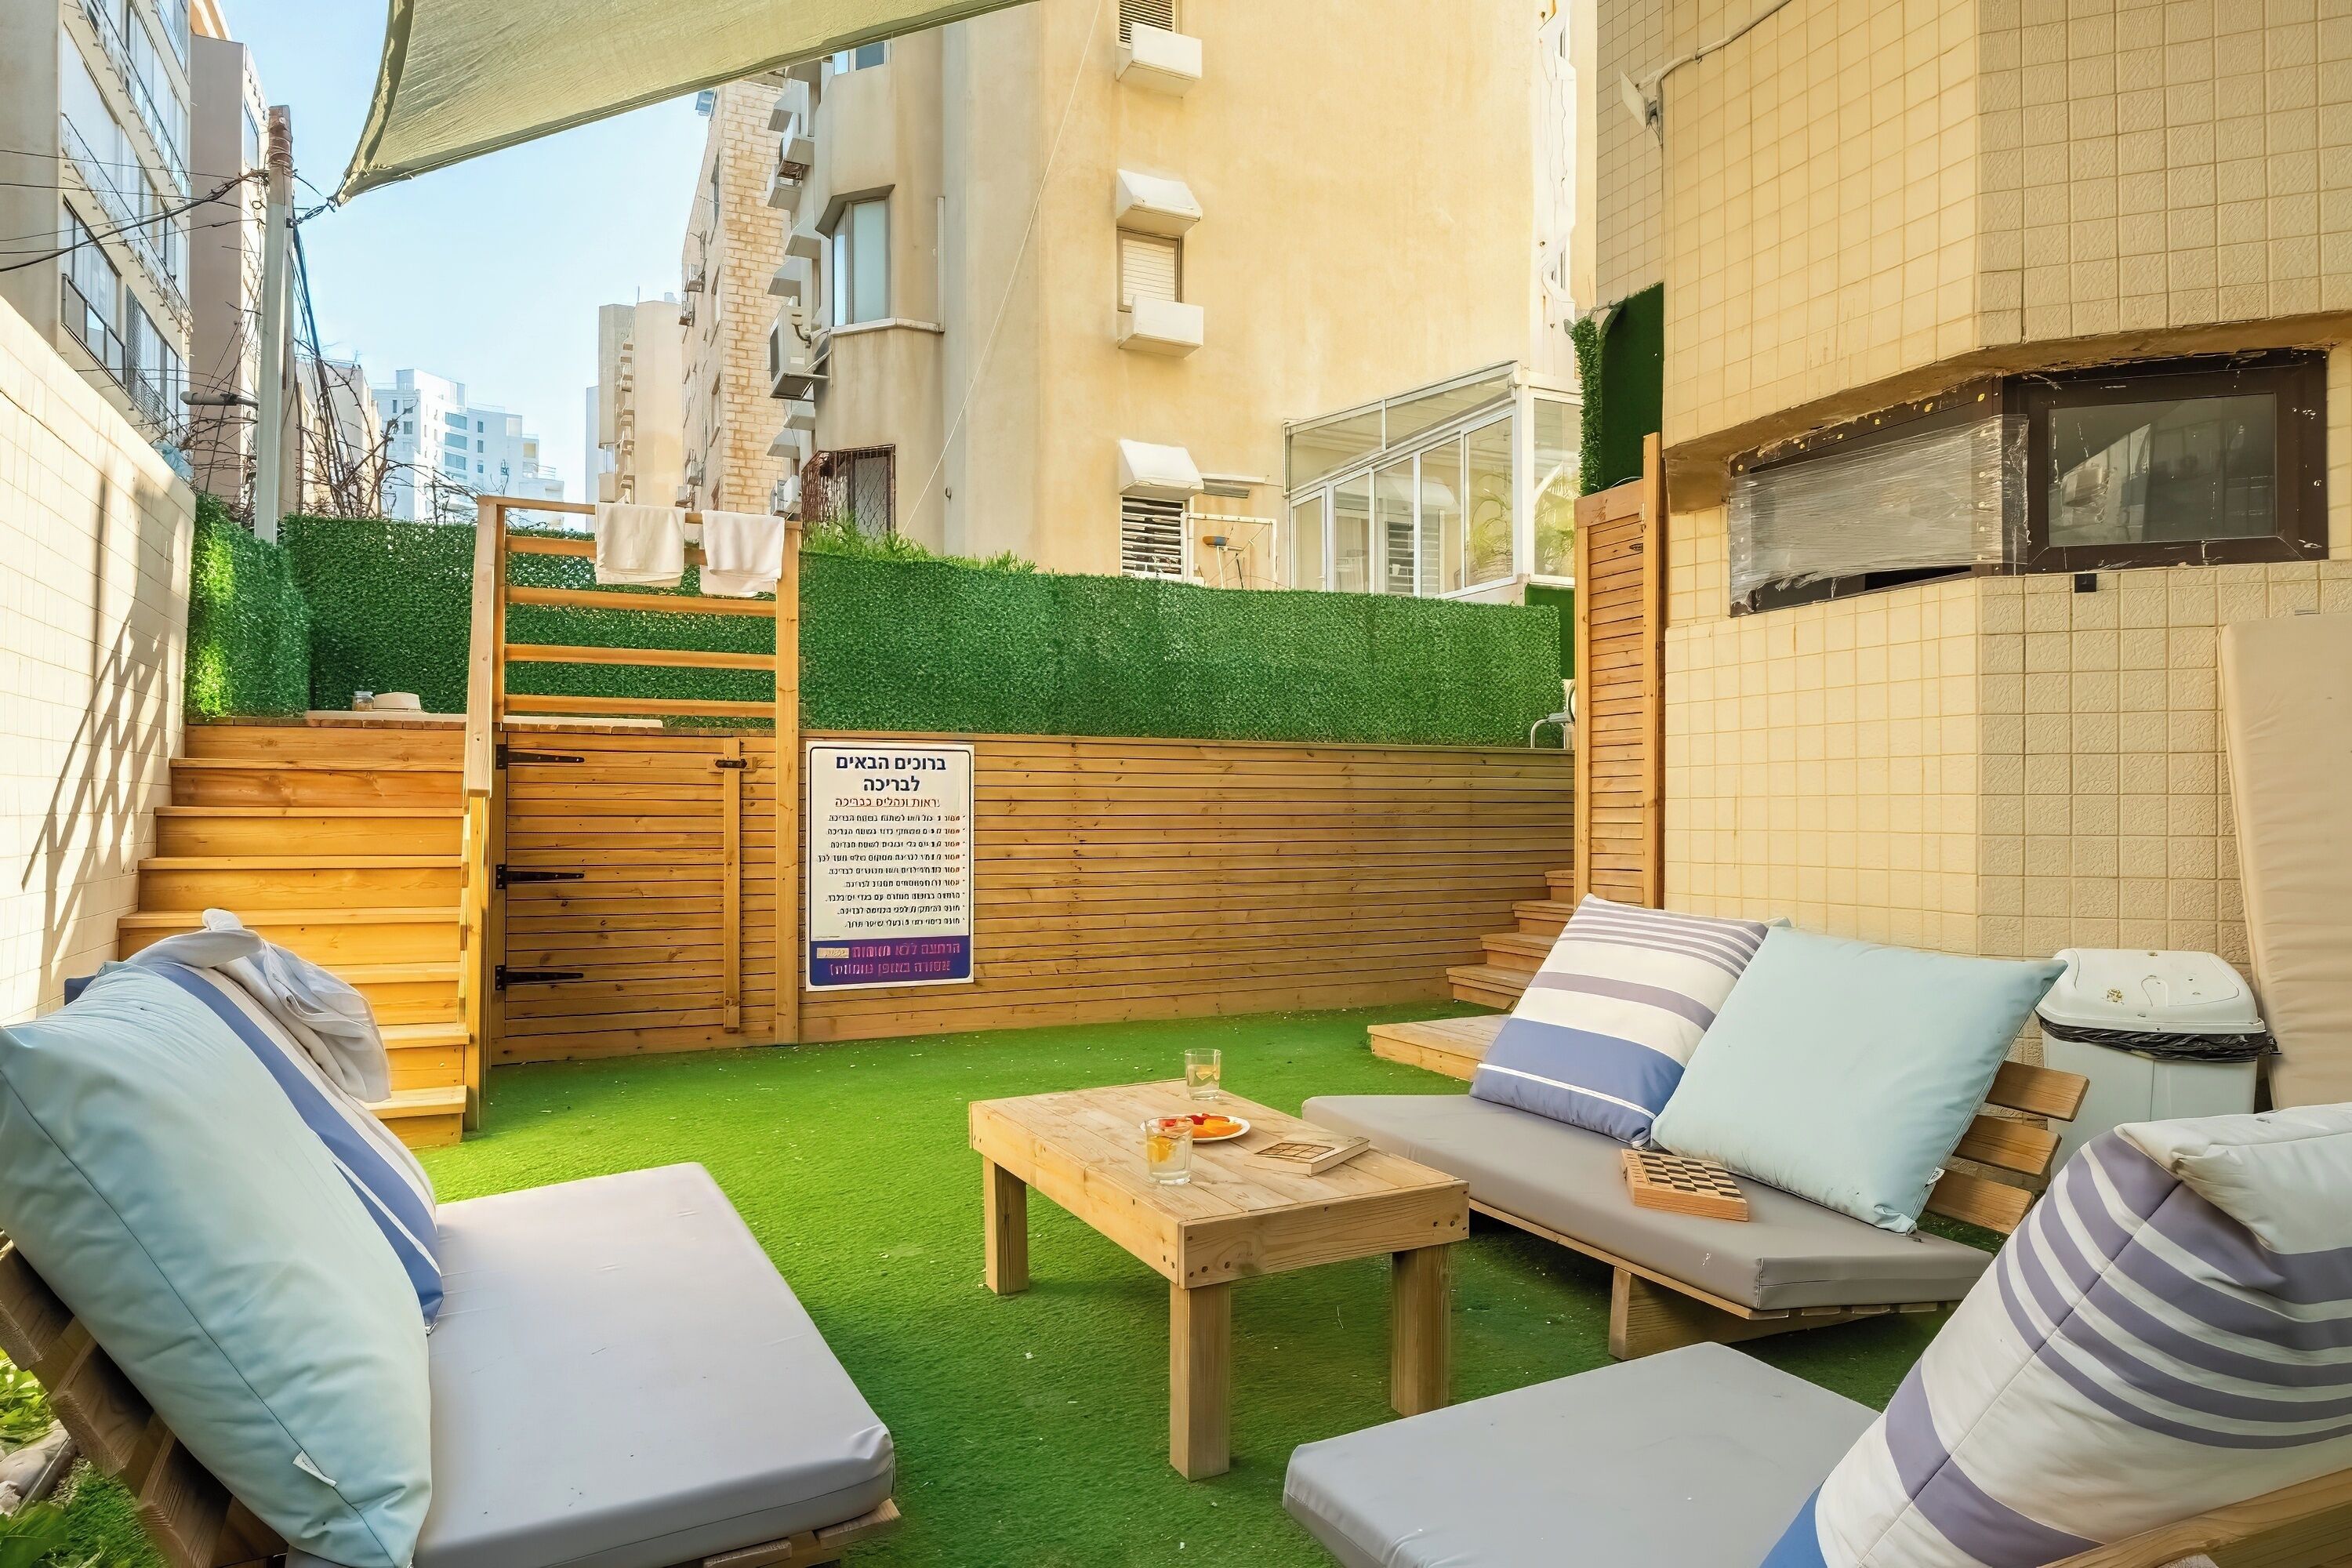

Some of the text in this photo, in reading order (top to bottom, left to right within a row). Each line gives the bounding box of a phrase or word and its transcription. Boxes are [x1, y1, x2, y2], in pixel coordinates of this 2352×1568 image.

[836, 756, 946, 771] ברוכים הבאים
[863, 775, 920, 791] לבריכה
